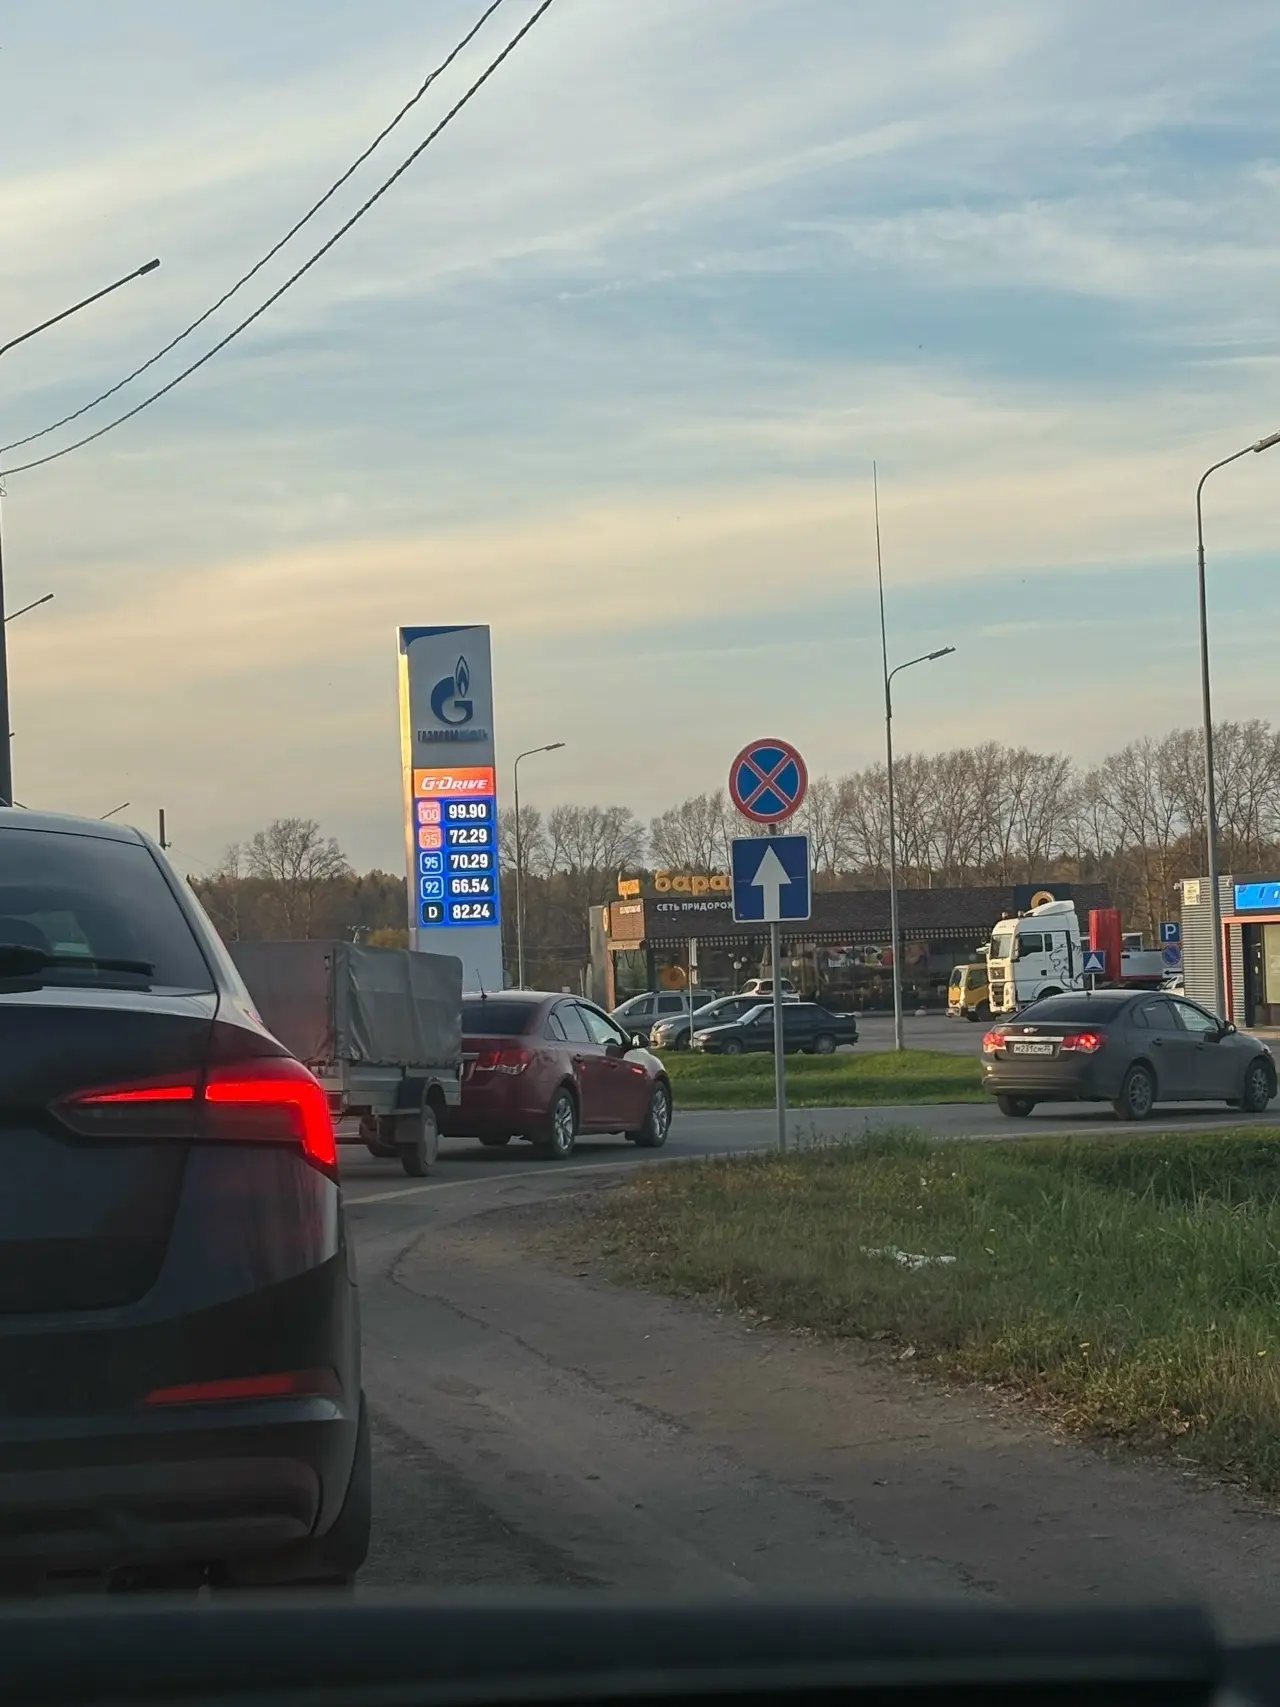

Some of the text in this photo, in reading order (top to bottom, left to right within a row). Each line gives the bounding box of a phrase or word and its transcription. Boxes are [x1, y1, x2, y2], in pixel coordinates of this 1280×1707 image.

[448, 803, 487, 819] 99.90
[449, 828, 488, 844] 72.29
[424, 853, 489, 869] 95 70.29
[425, 878, 490, 894] 92 66.54
[428, 904, 491, 919] D 82.24
[656, 903, 680, 912] СЕТЬ
